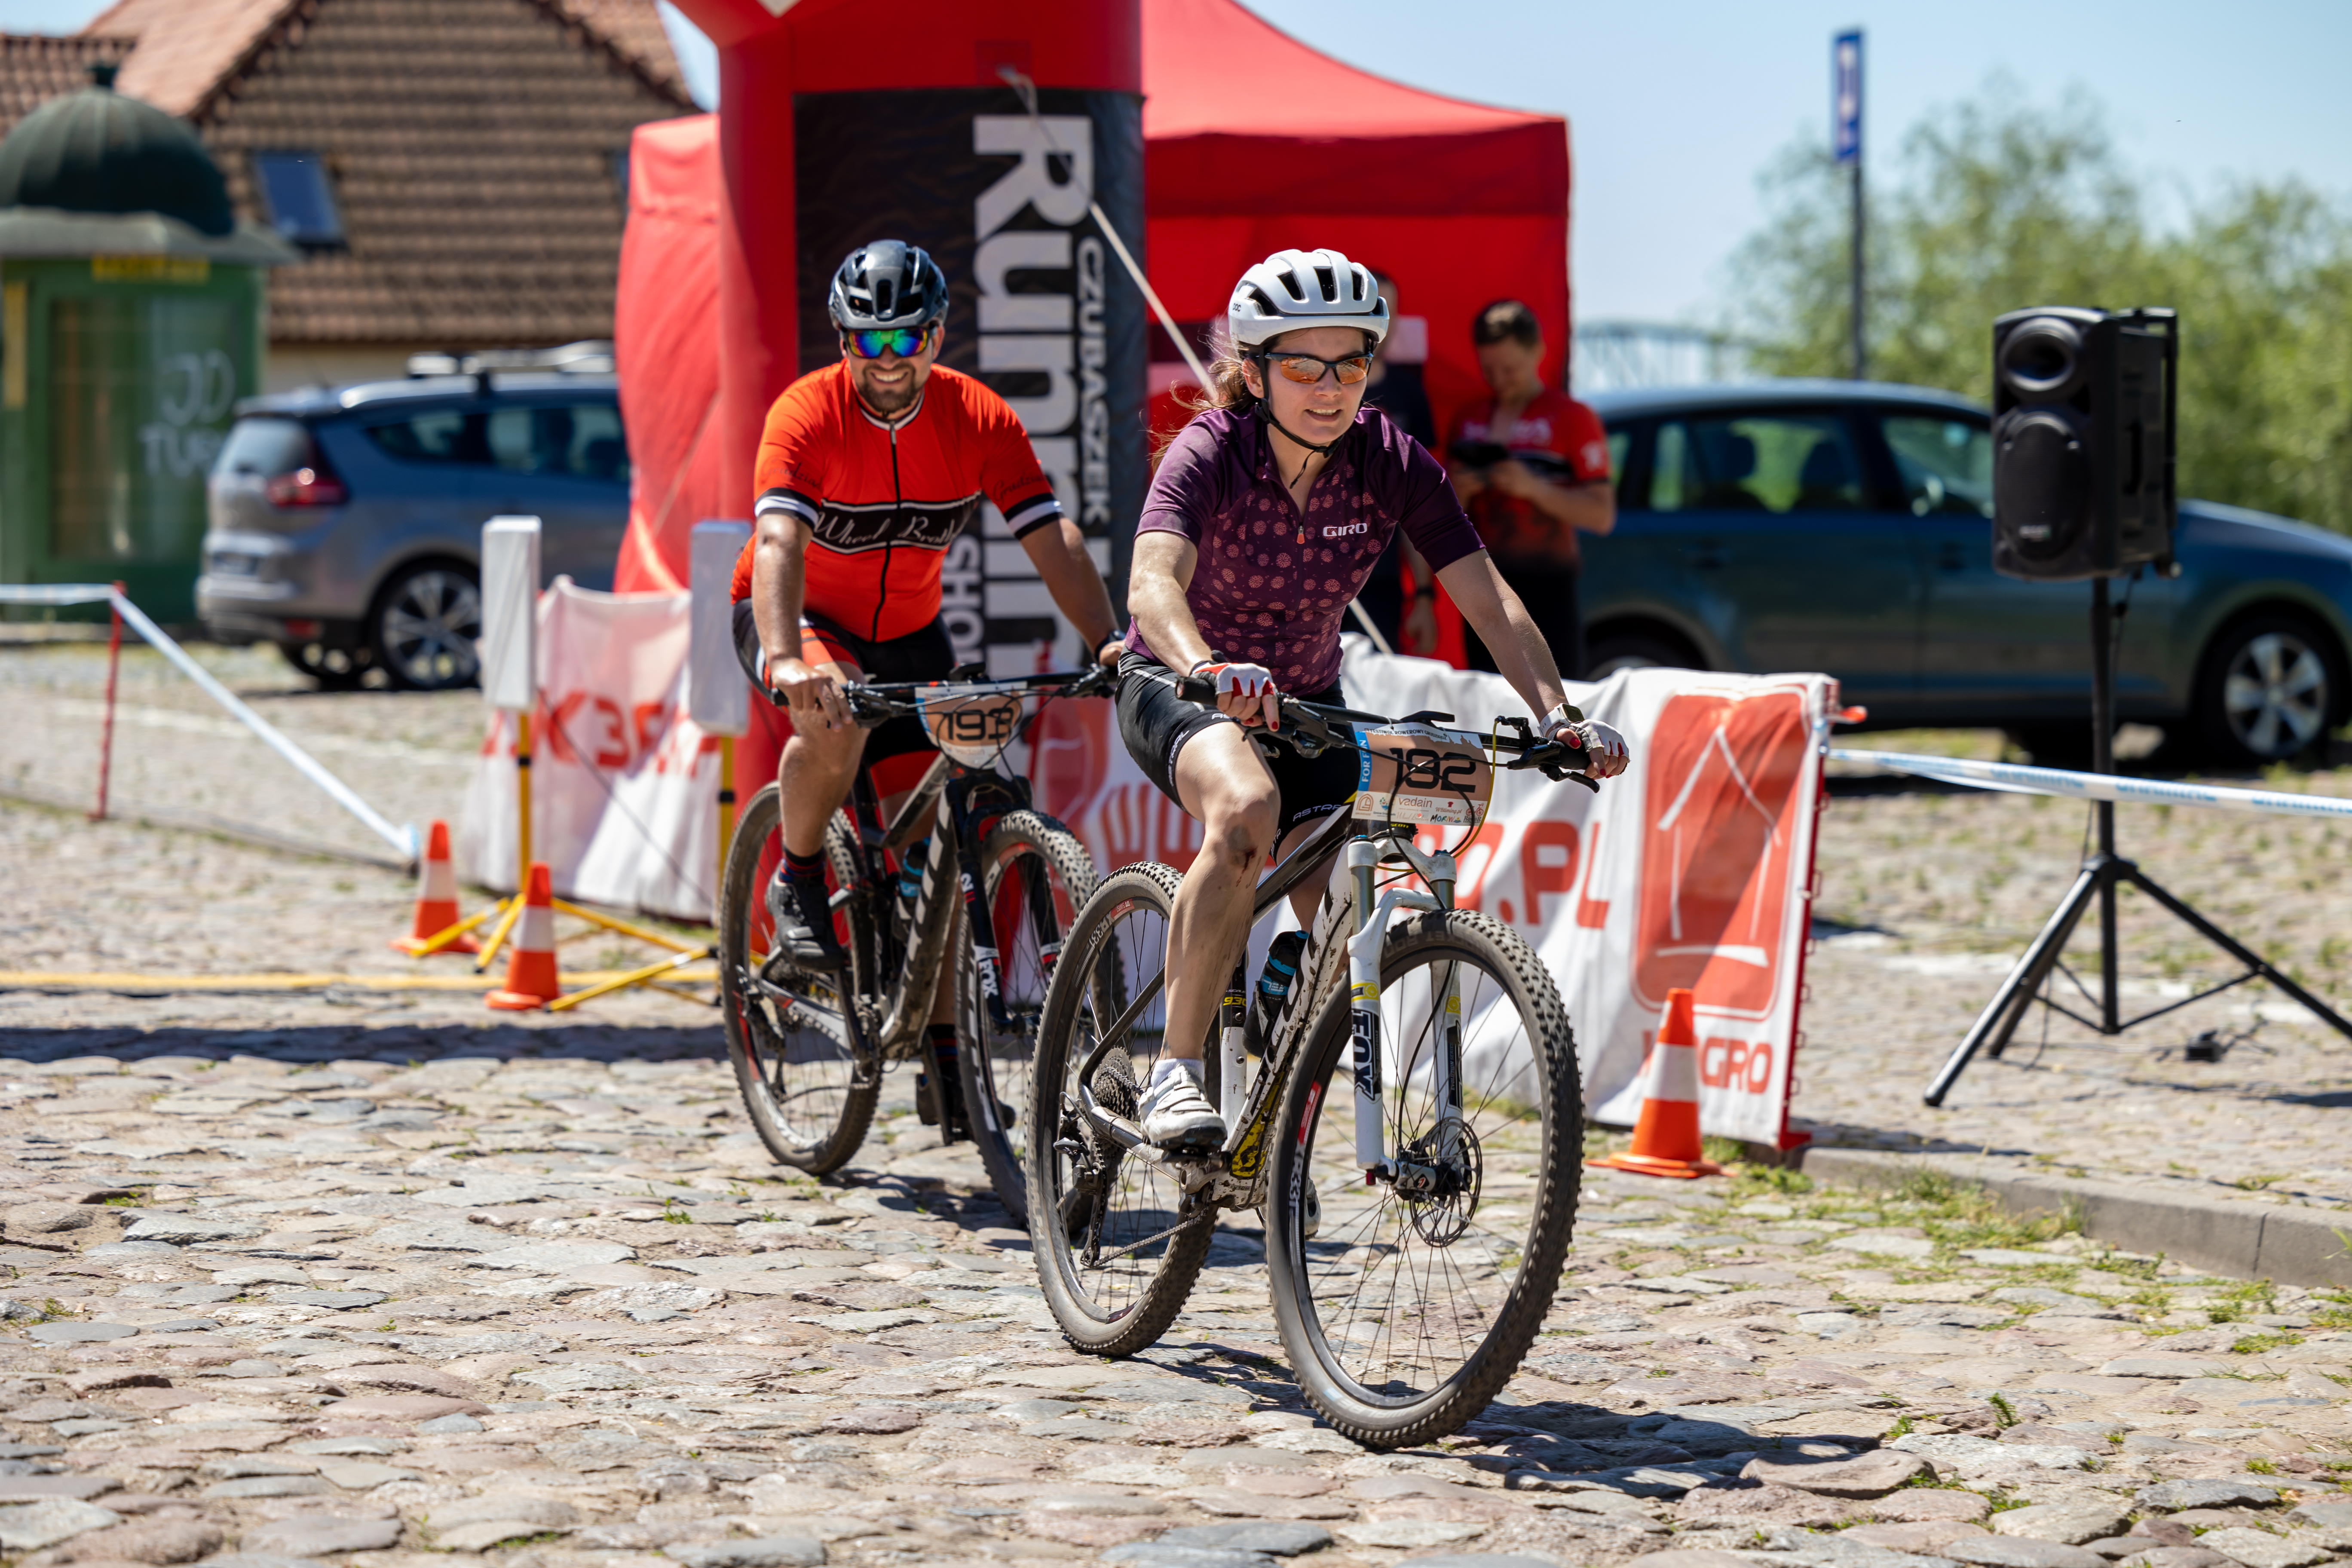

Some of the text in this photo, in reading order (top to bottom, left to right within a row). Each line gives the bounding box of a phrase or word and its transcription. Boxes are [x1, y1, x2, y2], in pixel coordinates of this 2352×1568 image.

[1077, 236, 1110, 525] CZUBASZEK
[816, 511, 890, 544] Wheel
[1323, 523, 1367, 537] GIRO
[944, 707, 1014, 741] 193
[1361, 761, 1370, 782] FOR
[1389, 747, 1476, 793] 192
[1399, 797, 1432, 808] vadain
[978, 958, 999, 999] FOX
[1352, 1011, 1374, 1099] FOX
